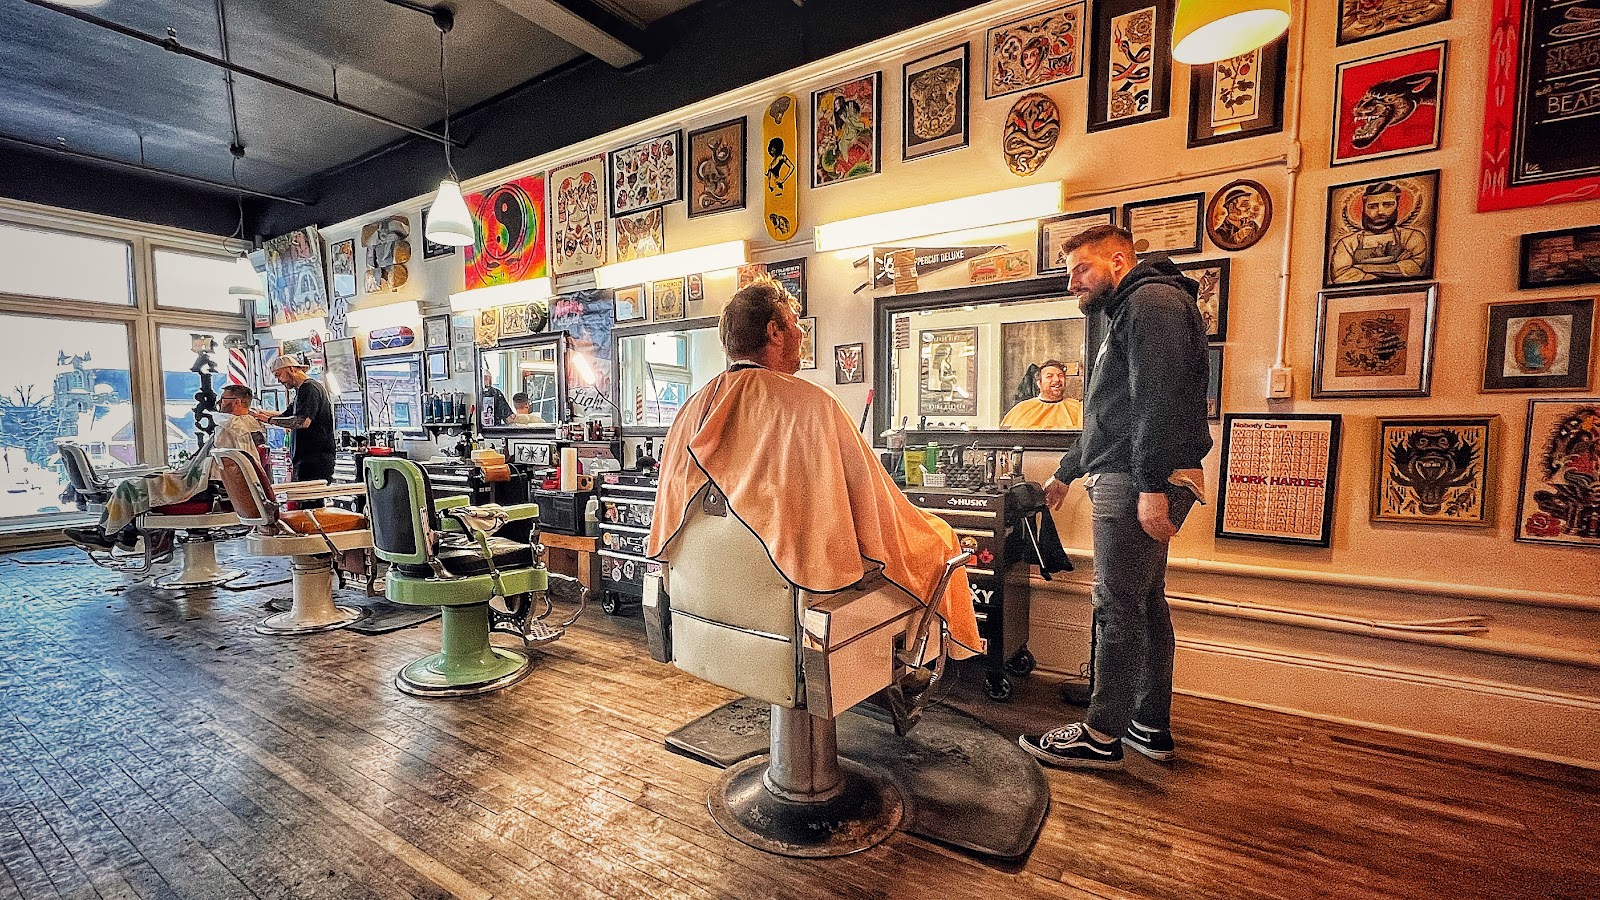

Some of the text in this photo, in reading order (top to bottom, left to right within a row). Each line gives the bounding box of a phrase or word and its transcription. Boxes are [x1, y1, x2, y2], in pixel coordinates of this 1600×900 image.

[914, 249, 965, 266] PPERCUT DELUXE
[1233, 422, 1262, 430] Nobody
[1232, 430, 1271, 439] WORK
[1232, 438, 1270, 446] WORK
[1232, 445, 1270, 454] WORK
[1231, 453, 1269, 461] WORK
[1230, 460, 1269, 469] WORK
[1230, 468, 1268, 476] WORK
[1230, 475, 1324, 488] WORK HARDER
[1229, 483, 1267, 492] WORK
[1228, 490, 1267, 499] WORK
[957, 498, 988, 507] HUSKY
[1228, 498, 1266, 507] WORK
[1228, 506, 1266, 514] WORK
[1227, 513, 1265, 522] WORK
[1226, 521, 1264, 529] WORK
